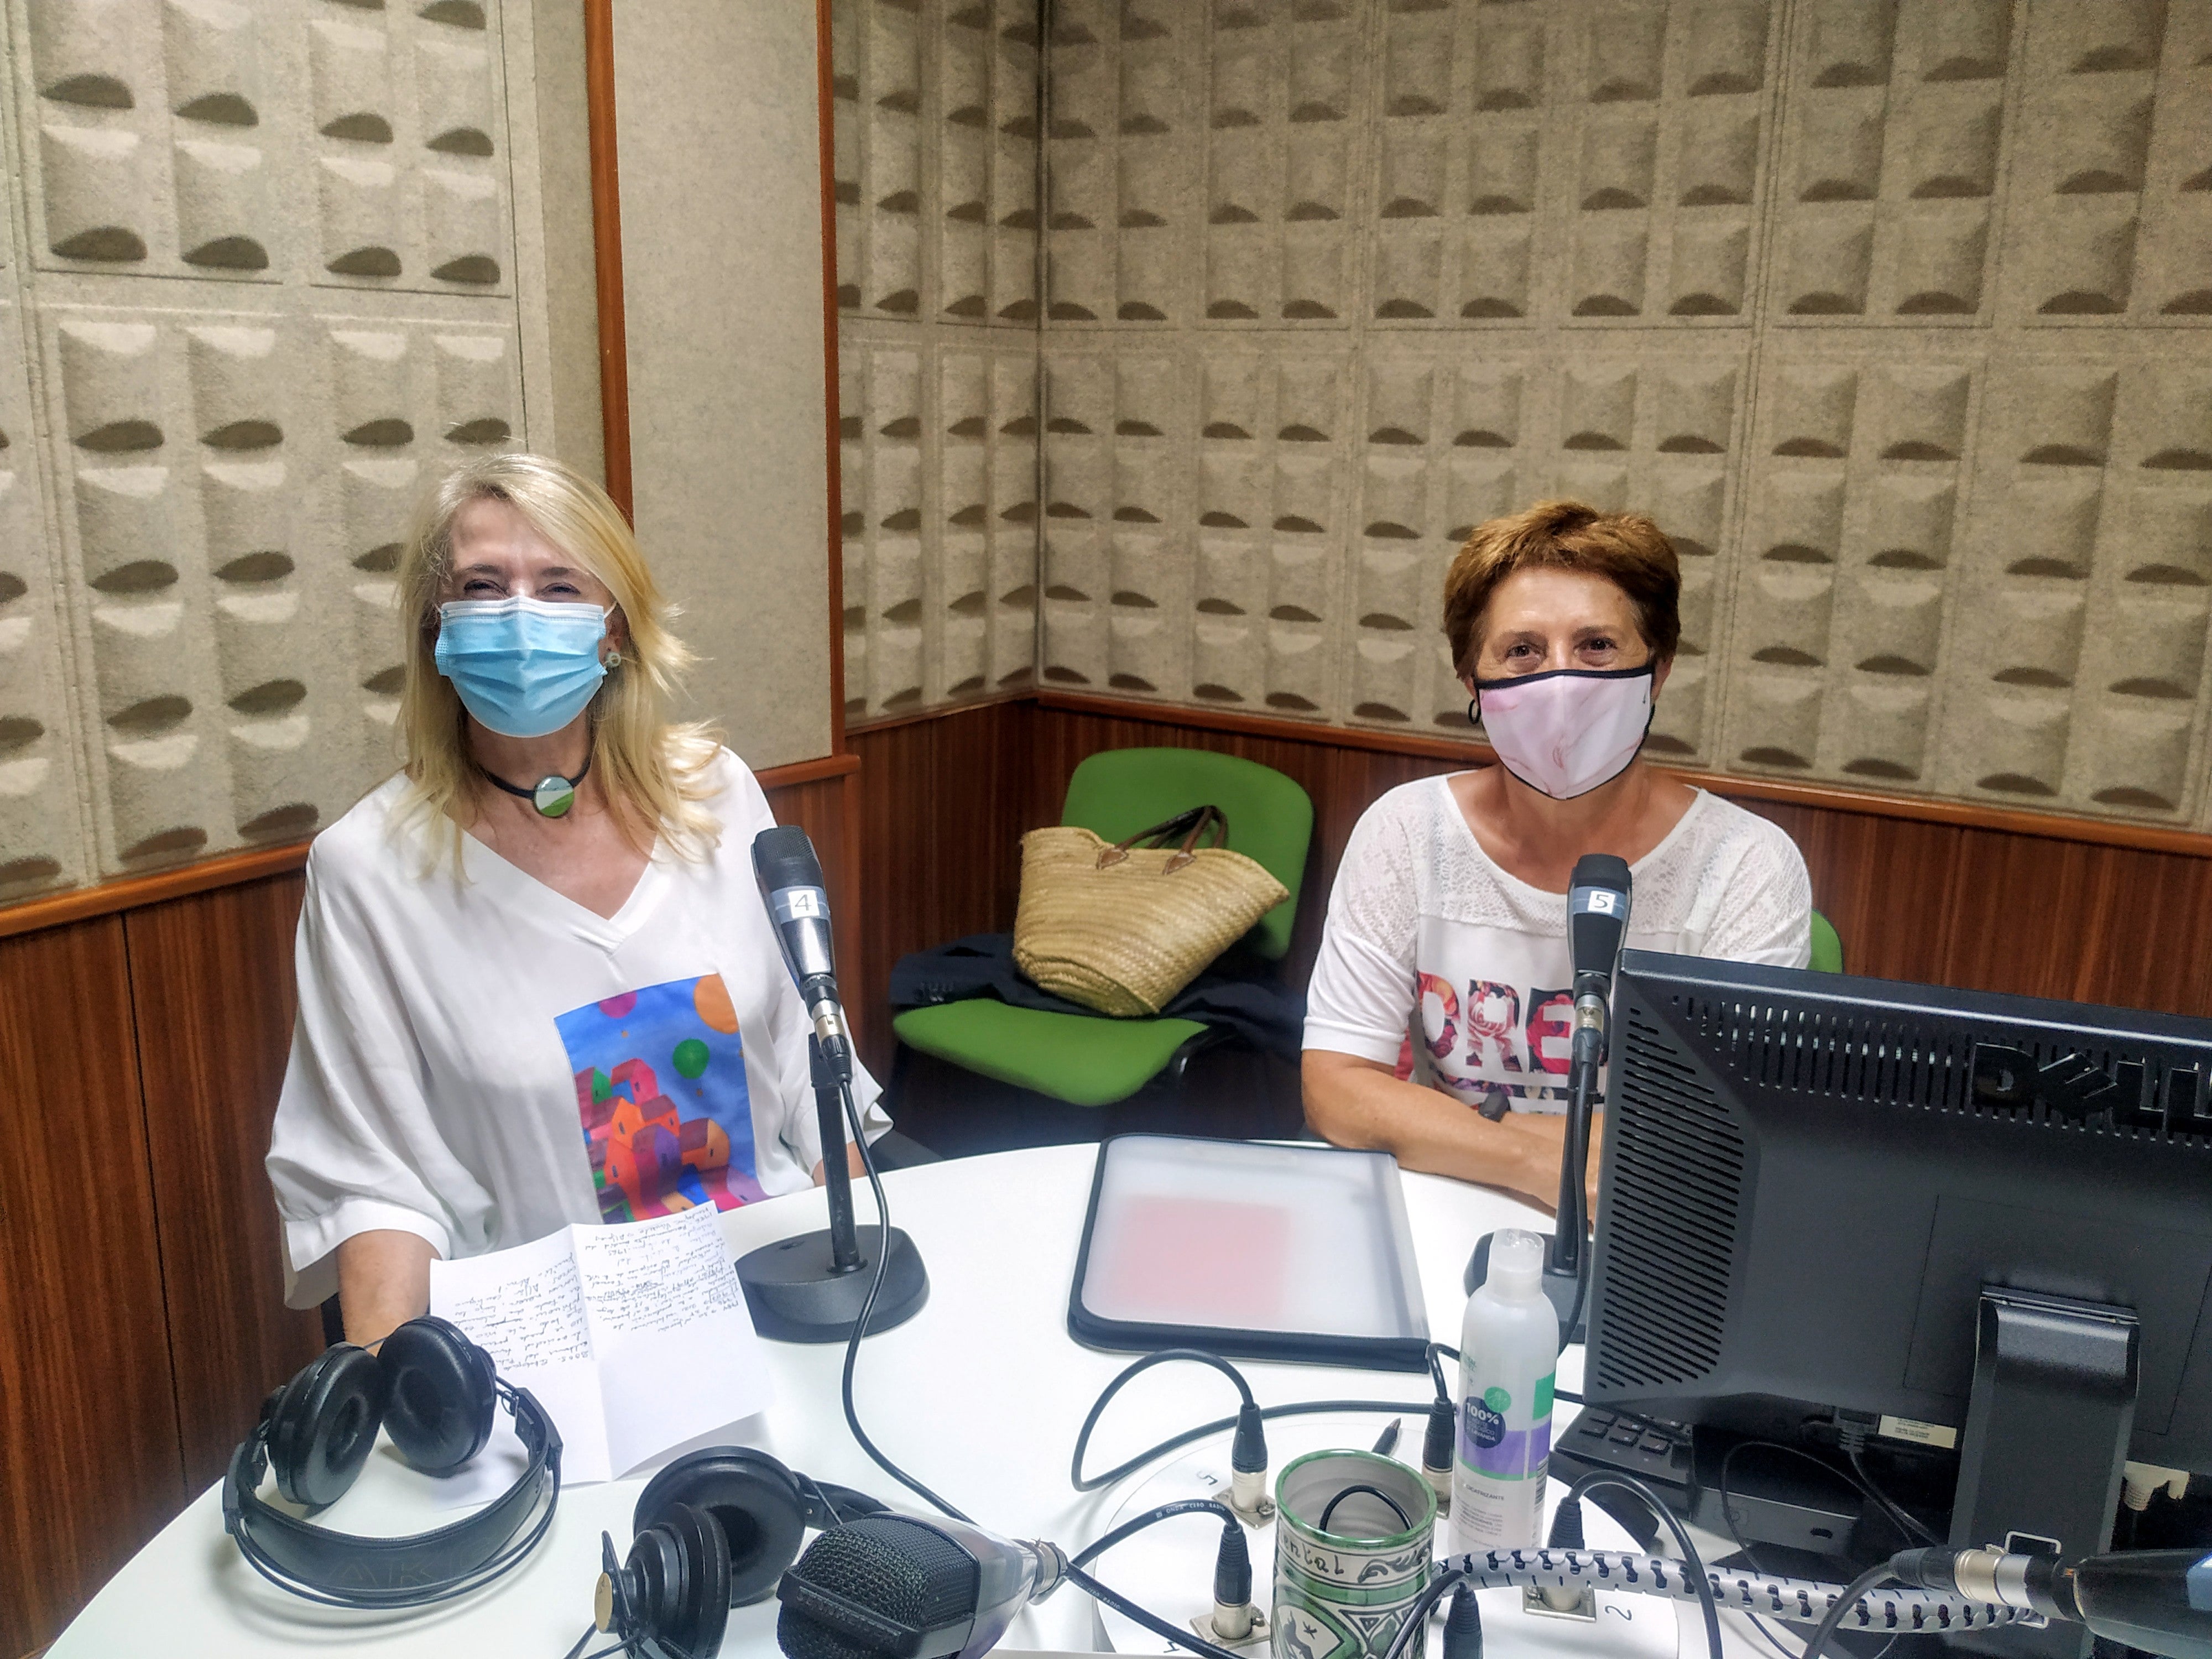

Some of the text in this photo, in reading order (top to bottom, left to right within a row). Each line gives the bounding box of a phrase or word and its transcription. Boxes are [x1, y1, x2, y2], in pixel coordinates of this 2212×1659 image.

[794, 894, 812, 912] 4
[1593, 894, 1609, 910] 5
[1466, 1402, 1499, 1425] 100%
